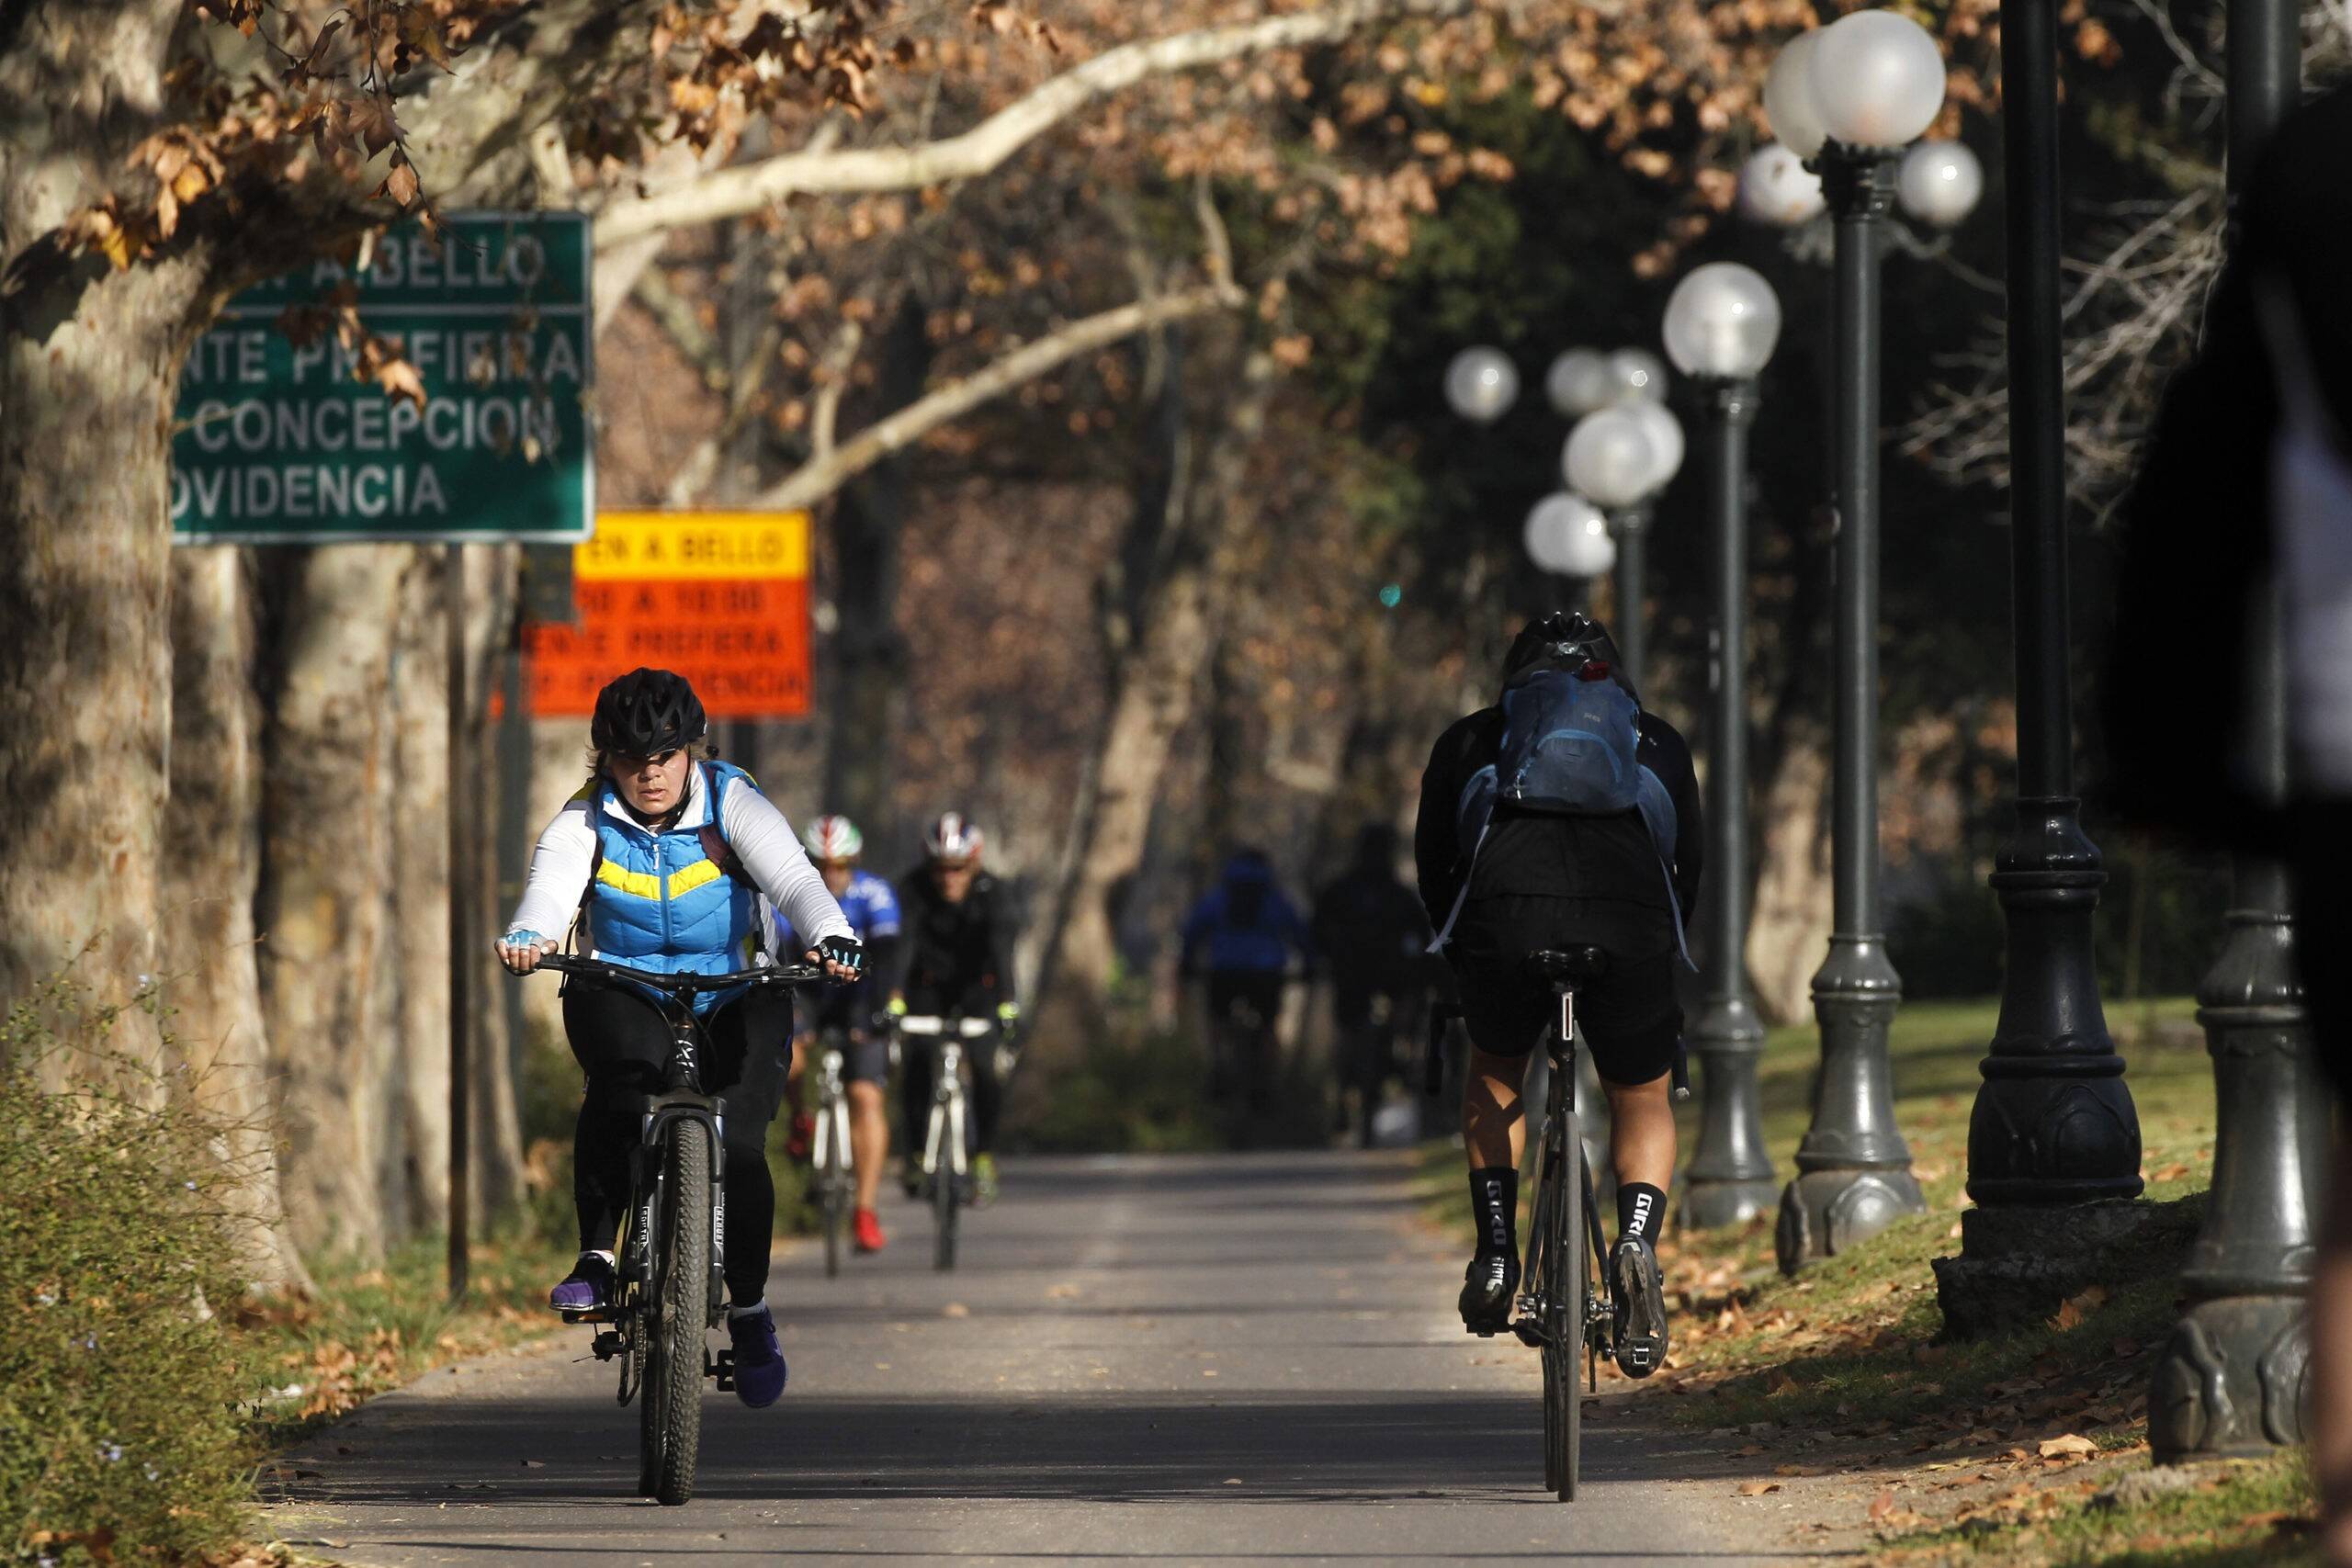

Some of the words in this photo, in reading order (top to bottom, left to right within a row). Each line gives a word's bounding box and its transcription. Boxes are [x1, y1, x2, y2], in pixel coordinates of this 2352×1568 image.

[192, 397, 558, 454] CONCEPCION
[677, 528, 785, 565] BELLO
[1486, 1179, 1507, 1246] GIRO
